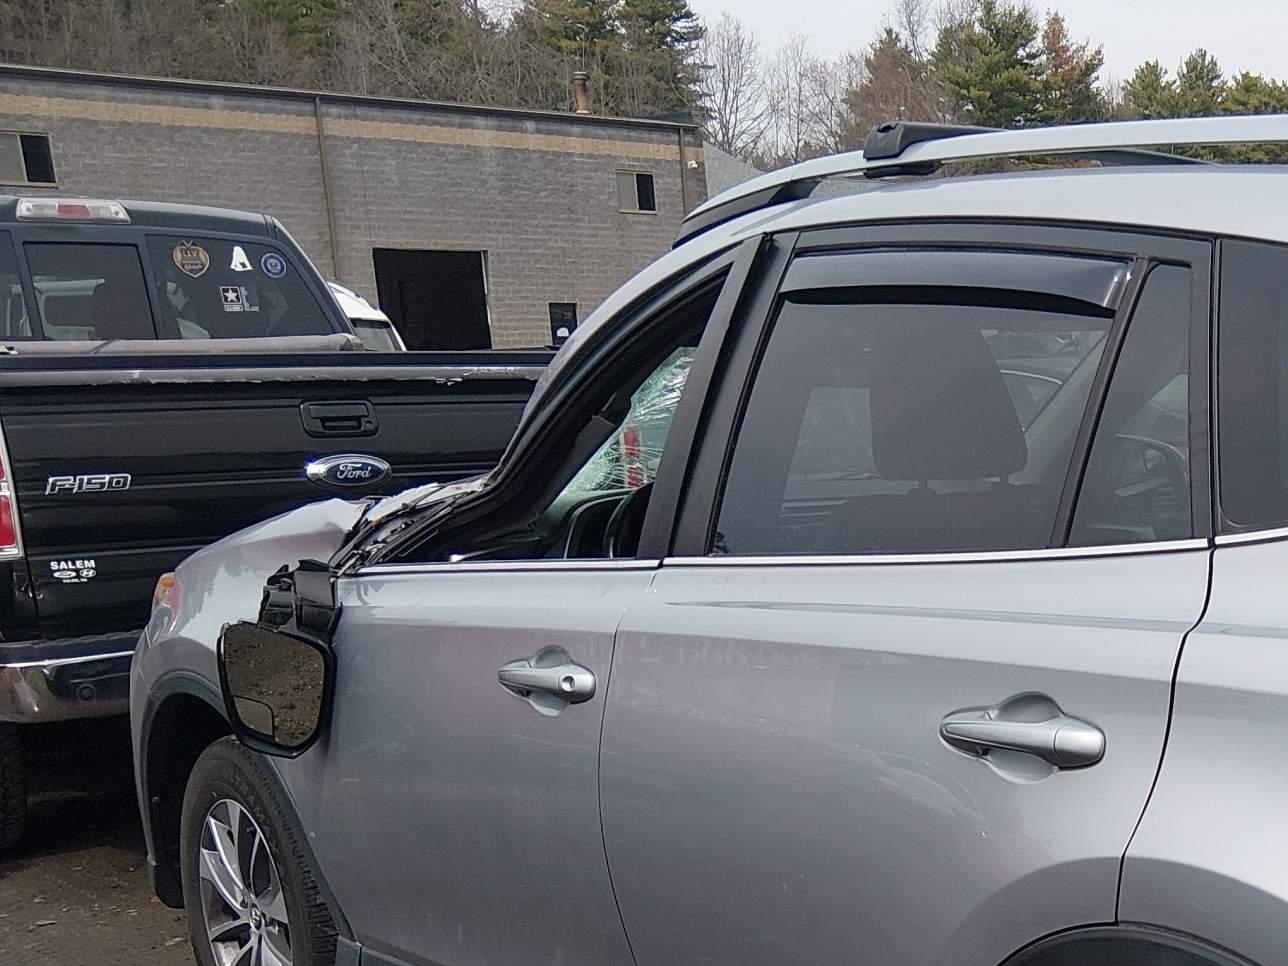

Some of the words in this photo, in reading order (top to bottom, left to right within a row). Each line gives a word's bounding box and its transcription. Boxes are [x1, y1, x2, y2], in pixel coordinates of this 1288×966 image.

[337, 463, 371, 478] Ford
[45, 473, 131, 495] F-150
[50, 560, 95, 570] SALEM
